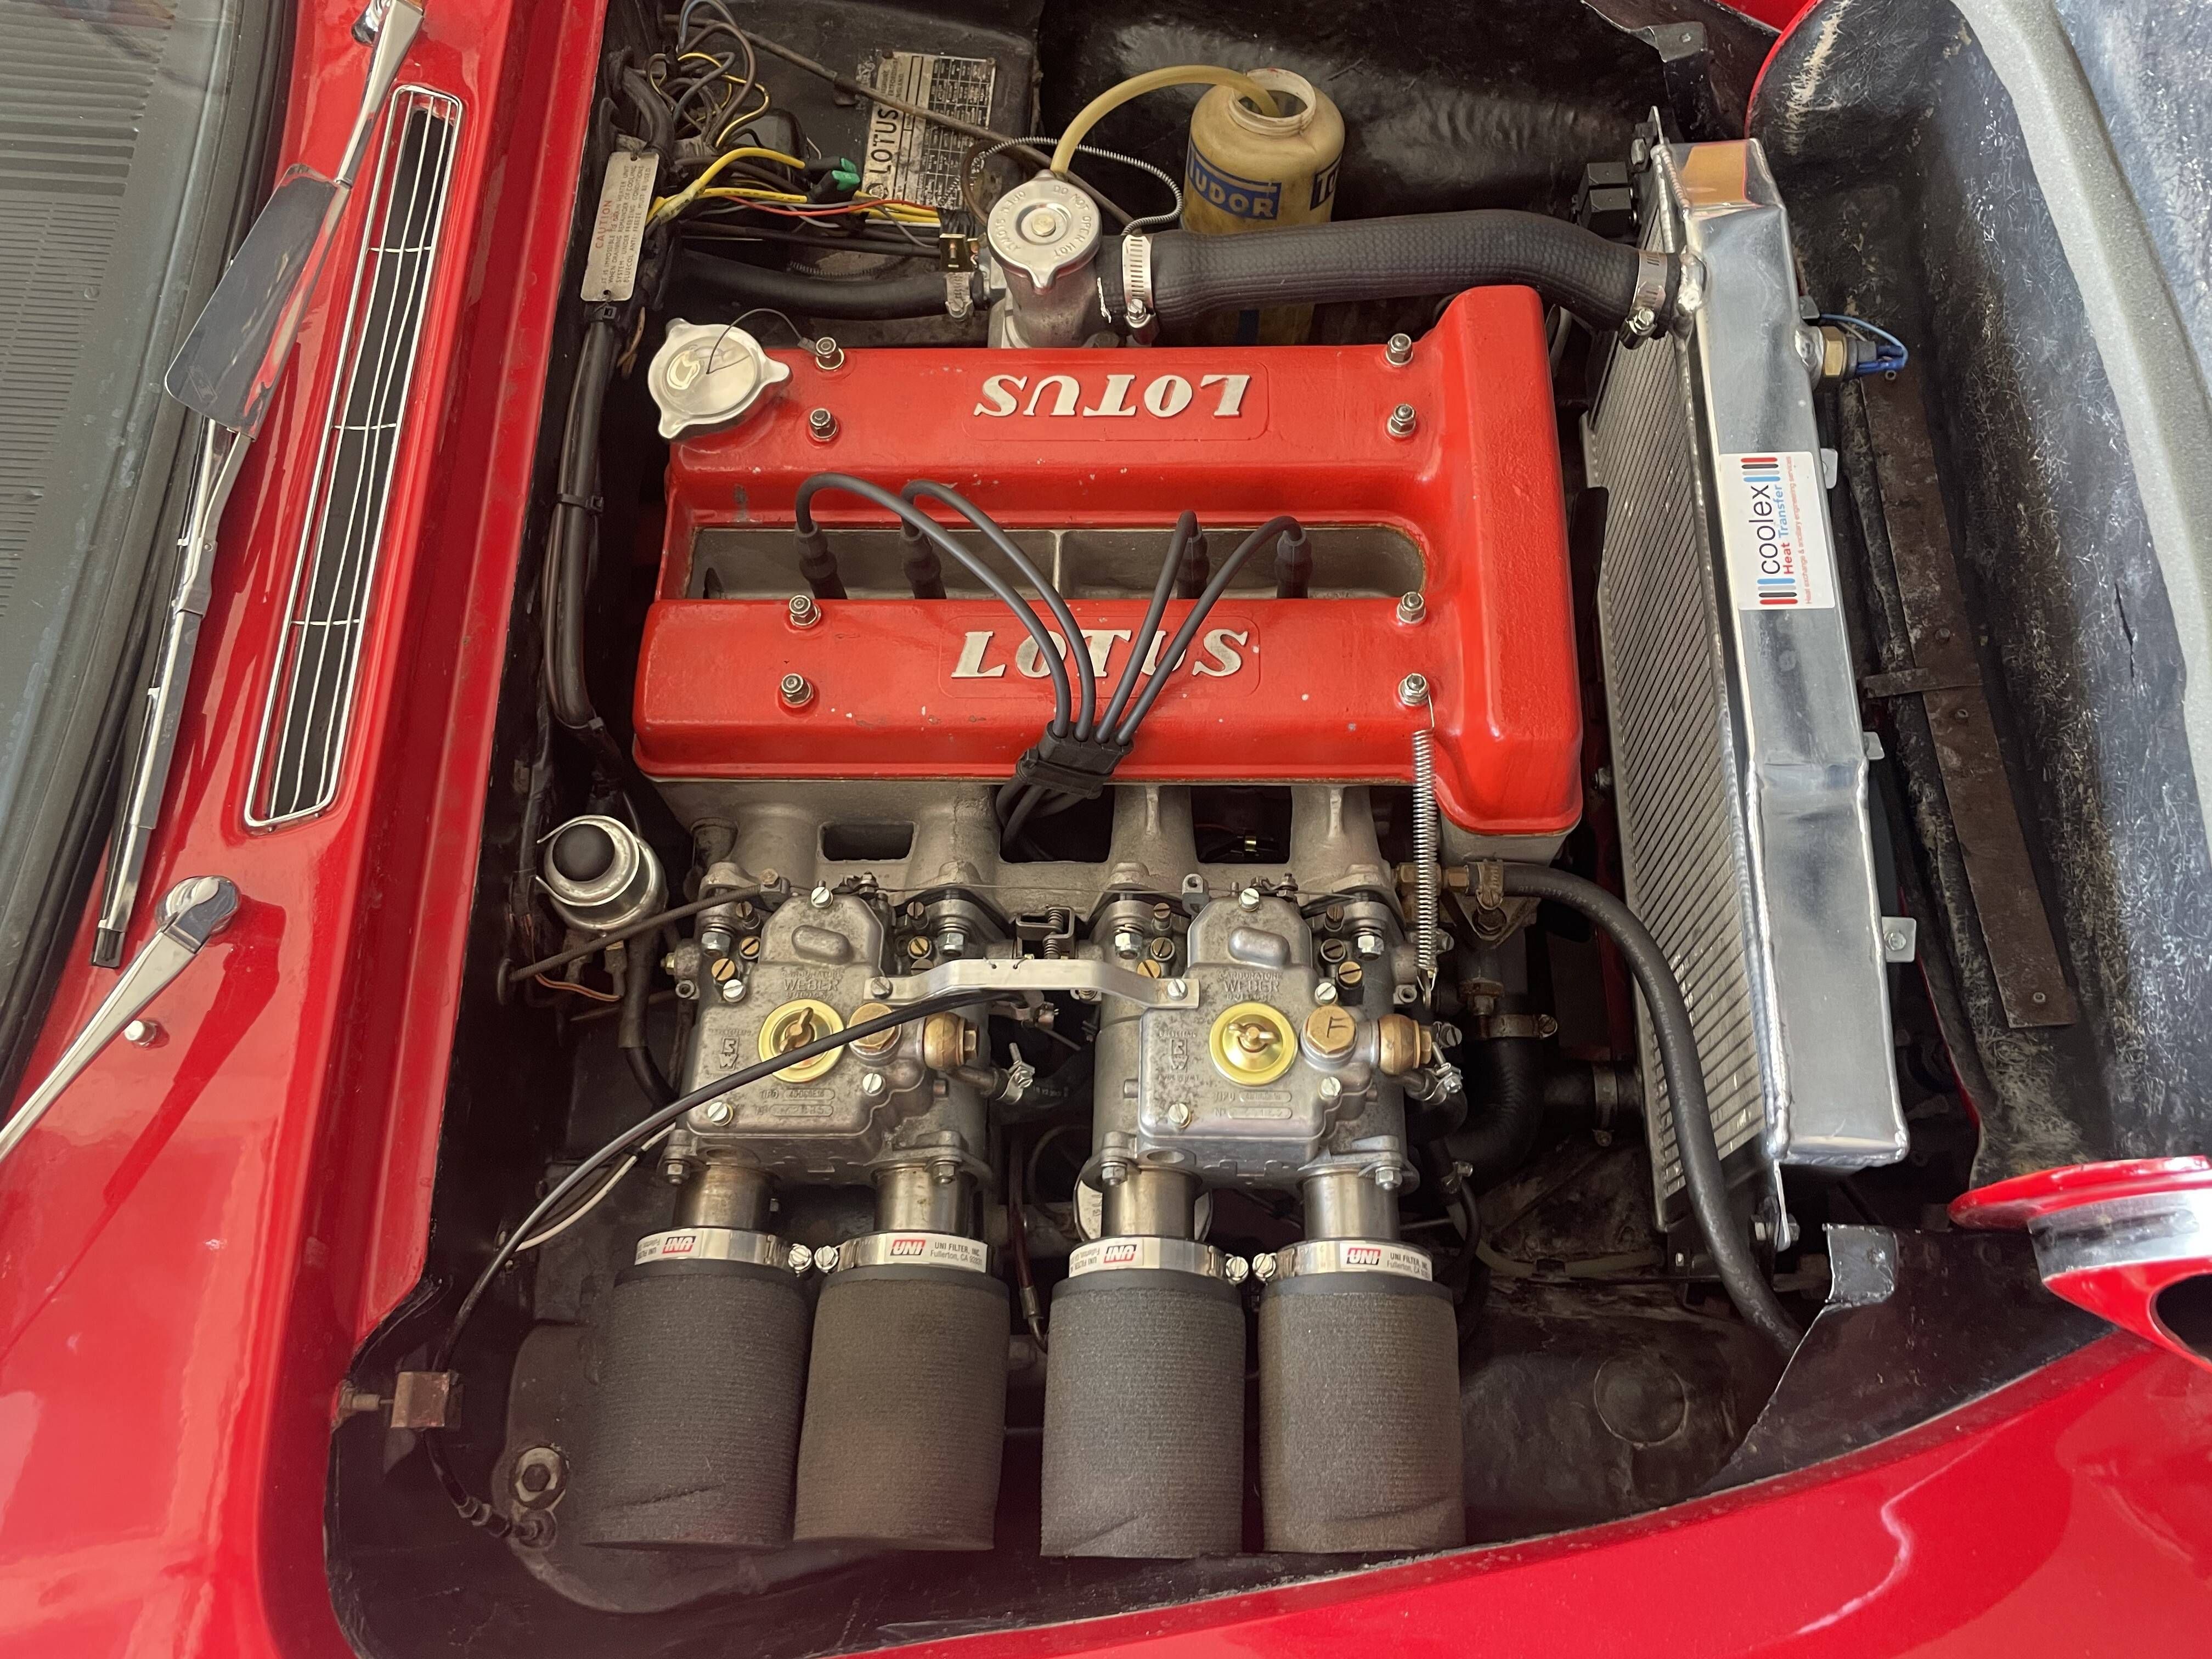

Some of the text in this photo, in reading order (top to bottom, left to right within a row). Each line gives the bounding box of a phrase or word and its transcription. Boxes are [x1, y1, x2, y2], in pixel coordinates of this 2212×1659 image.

[869, 109, 899, 174] LOTUS
[625, 205, 635, 232] FREEZING
[632, 166, 644, 201] CONDITIONS
[595, 201, 612, 249] CAUTION
[604, 235, 615, 267] IMPOSSIBLE
[617, 182, 626, 201] HEATER
[612, 235, 622, 263] DRAINING
[618, 203, 628, 232] REMAINDER
[626, 166, 636, 191] COOLING
[1053, 185, 1092, 257] DO NOT OPEN HOT
[623, 255, 633, 283] BLUECOL
[973, 374, 1250, 418] LOTUS
[1786, 456, 1794, 482] services
[1788, 483, 1800, 520] engineering
[1748, 485, 1780, 574] coolex
[1773, 484, 1794, 574] Heat Transfer
[1794, 521, 1804, 548] ancillary
[1801, 556, 1810, 587] exchange
[784, 979, 839, 991] WEBER
[1224, 980, 1279, 992] WEBER
[663, 1236, 695, 1253] UNI
[891, 1240, 925, 1256] UNI
[930, 1250, 959, 1262] Fullerton,
[1104, 1244, 1136, 1262] UNI
[1348, 1248, 1380, 1265] UNI
[1390, 1252, 1401, 1261] UNI
[1088, 1256, 1097, 1265] UNI
